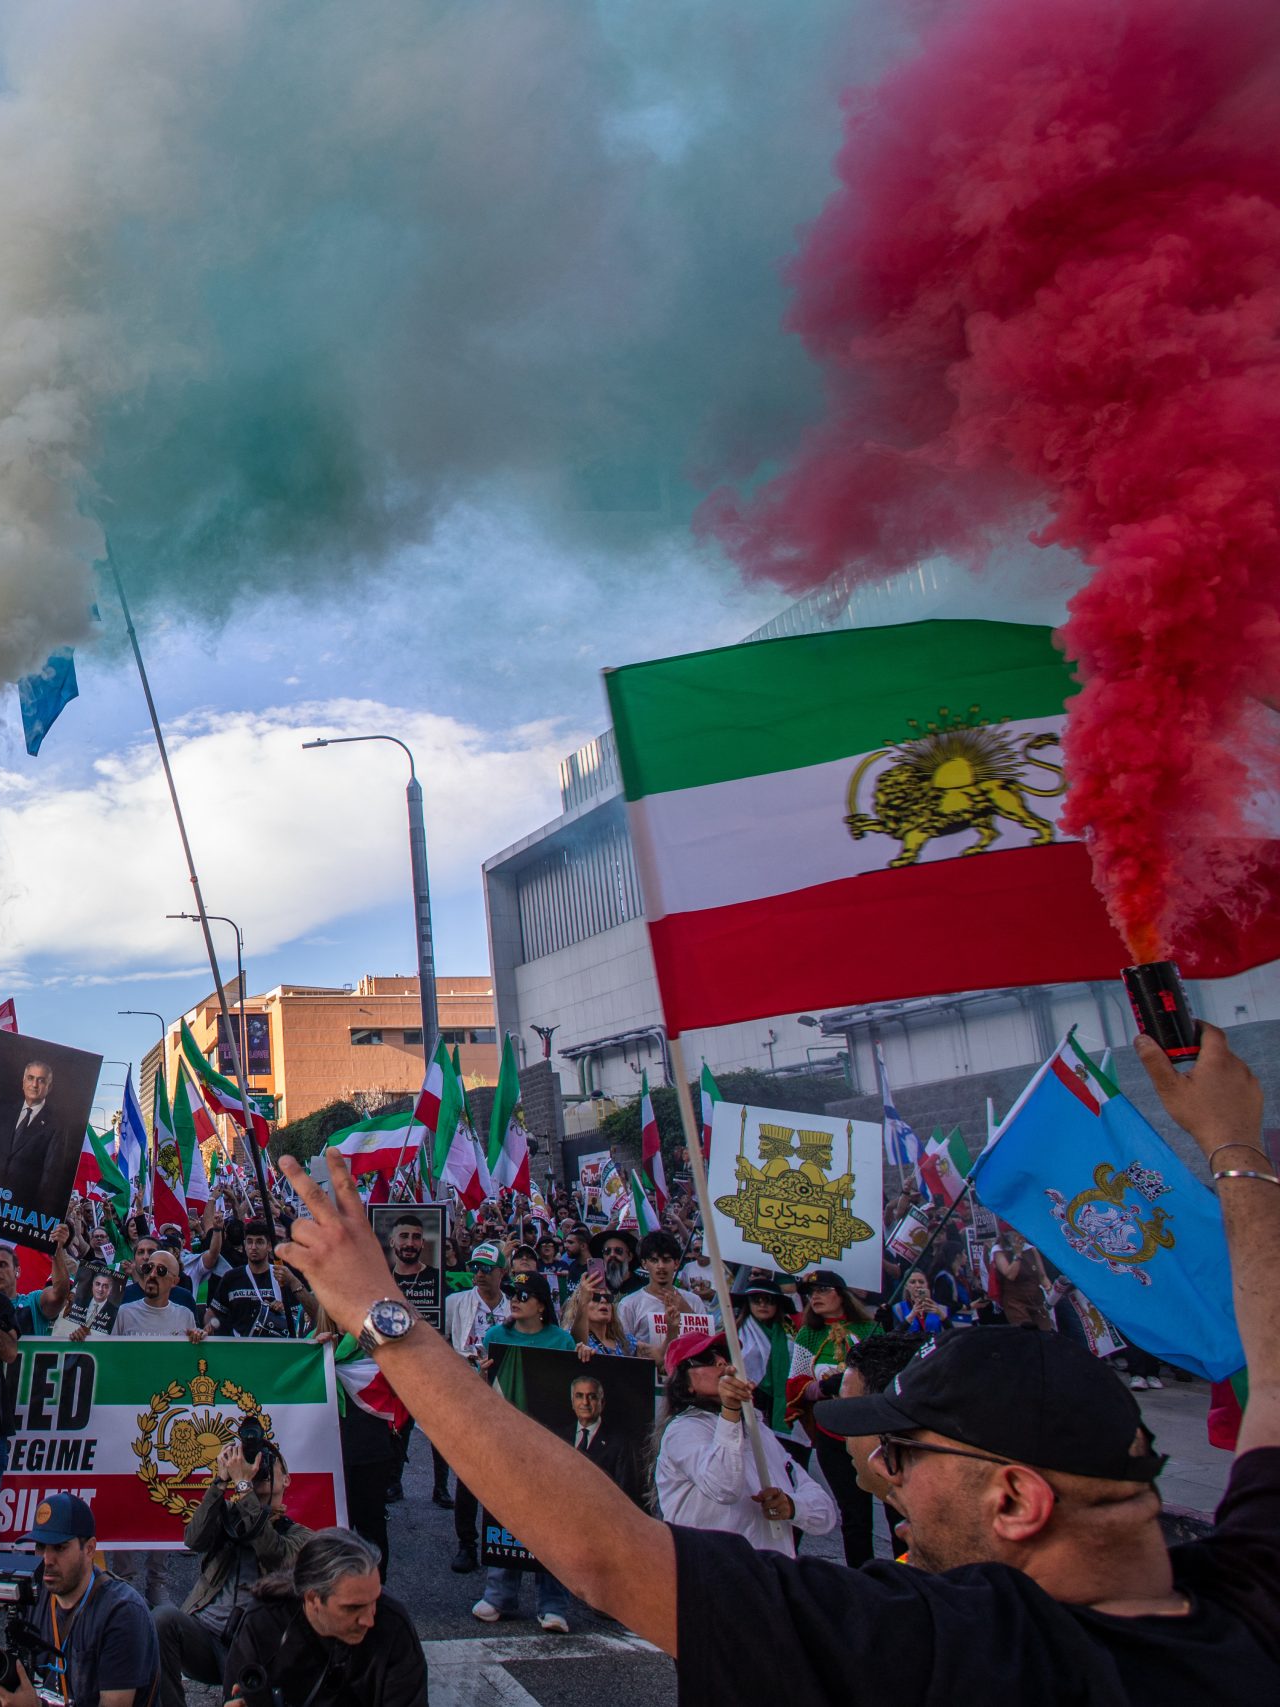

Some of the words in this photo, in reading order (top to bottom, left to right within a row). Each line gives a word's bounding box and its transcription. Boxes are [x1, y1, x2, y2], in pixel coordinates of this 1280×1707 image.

[3, 1221, 23, 1243] FOR
[85, 1262, 99, 1273] Long
[406, 1289, 434, 1297] Masihi
[684, 1315, 708, 1327] IRAN
[486, 1526, 524, 1547] RE
